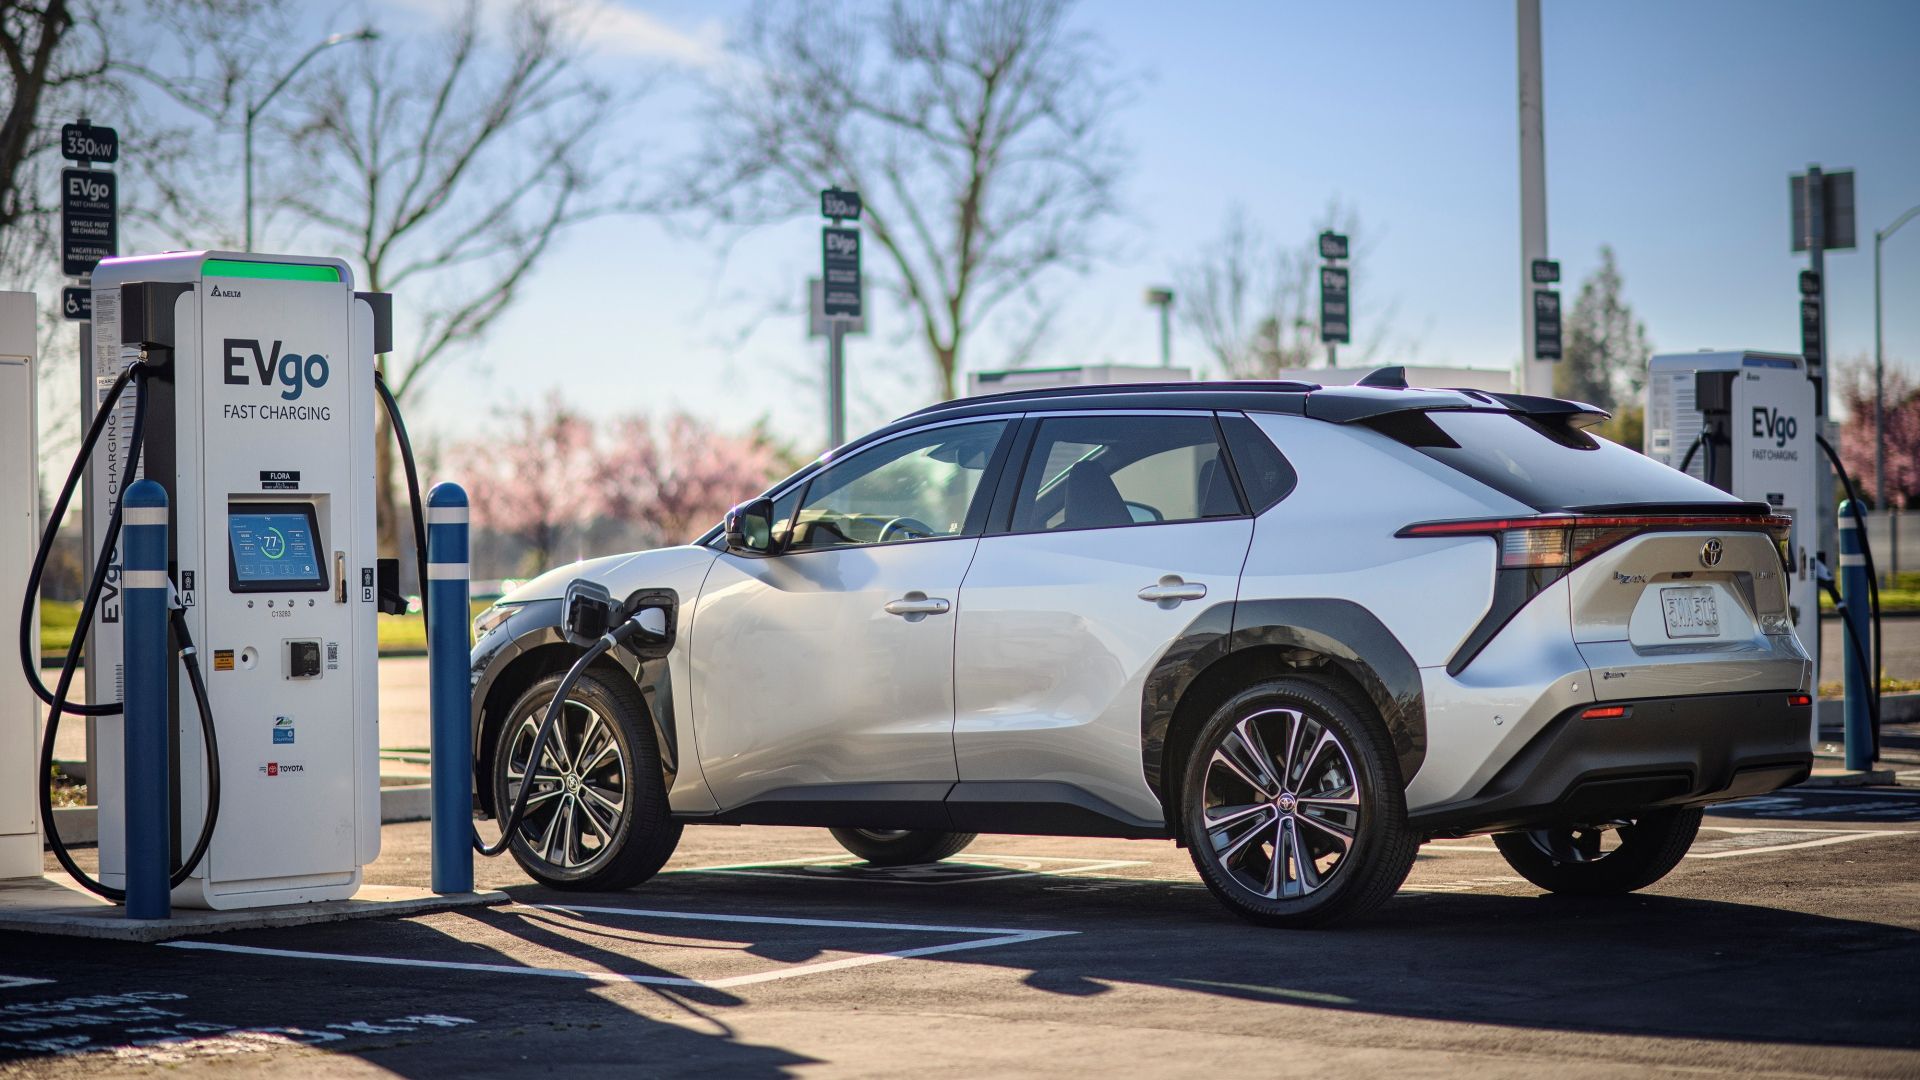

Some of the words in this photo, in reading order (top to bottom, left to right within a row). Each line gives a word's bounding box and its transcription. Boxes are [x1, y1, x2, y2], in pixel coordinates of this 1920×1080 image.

[67, 137, 113, 157] 350kW
[69, 178, 109, 201] EVgo
[70, 200, 82, 208] FAST
[83, 201, 109, 209] CHARGING
[80, 227, 108, 236] CHARGING
[224, 339, 329, 400] EVgo
[224, 405, 257, 419] FAST
[260, 405, 330, 420] CHARGING
[1752, 407, 1797, 448] EVgo
[108, 415, 117, 494] CHARGING
[1752, 449, 1766, 461] FAST
[1767, 450, 1798, 462] CHARGING
[270, 472, 290, 480] FLORA
[263, 536, 277, 548] 77
[185, 592, 193, 603] A
[365, 588, 371, 600] B
